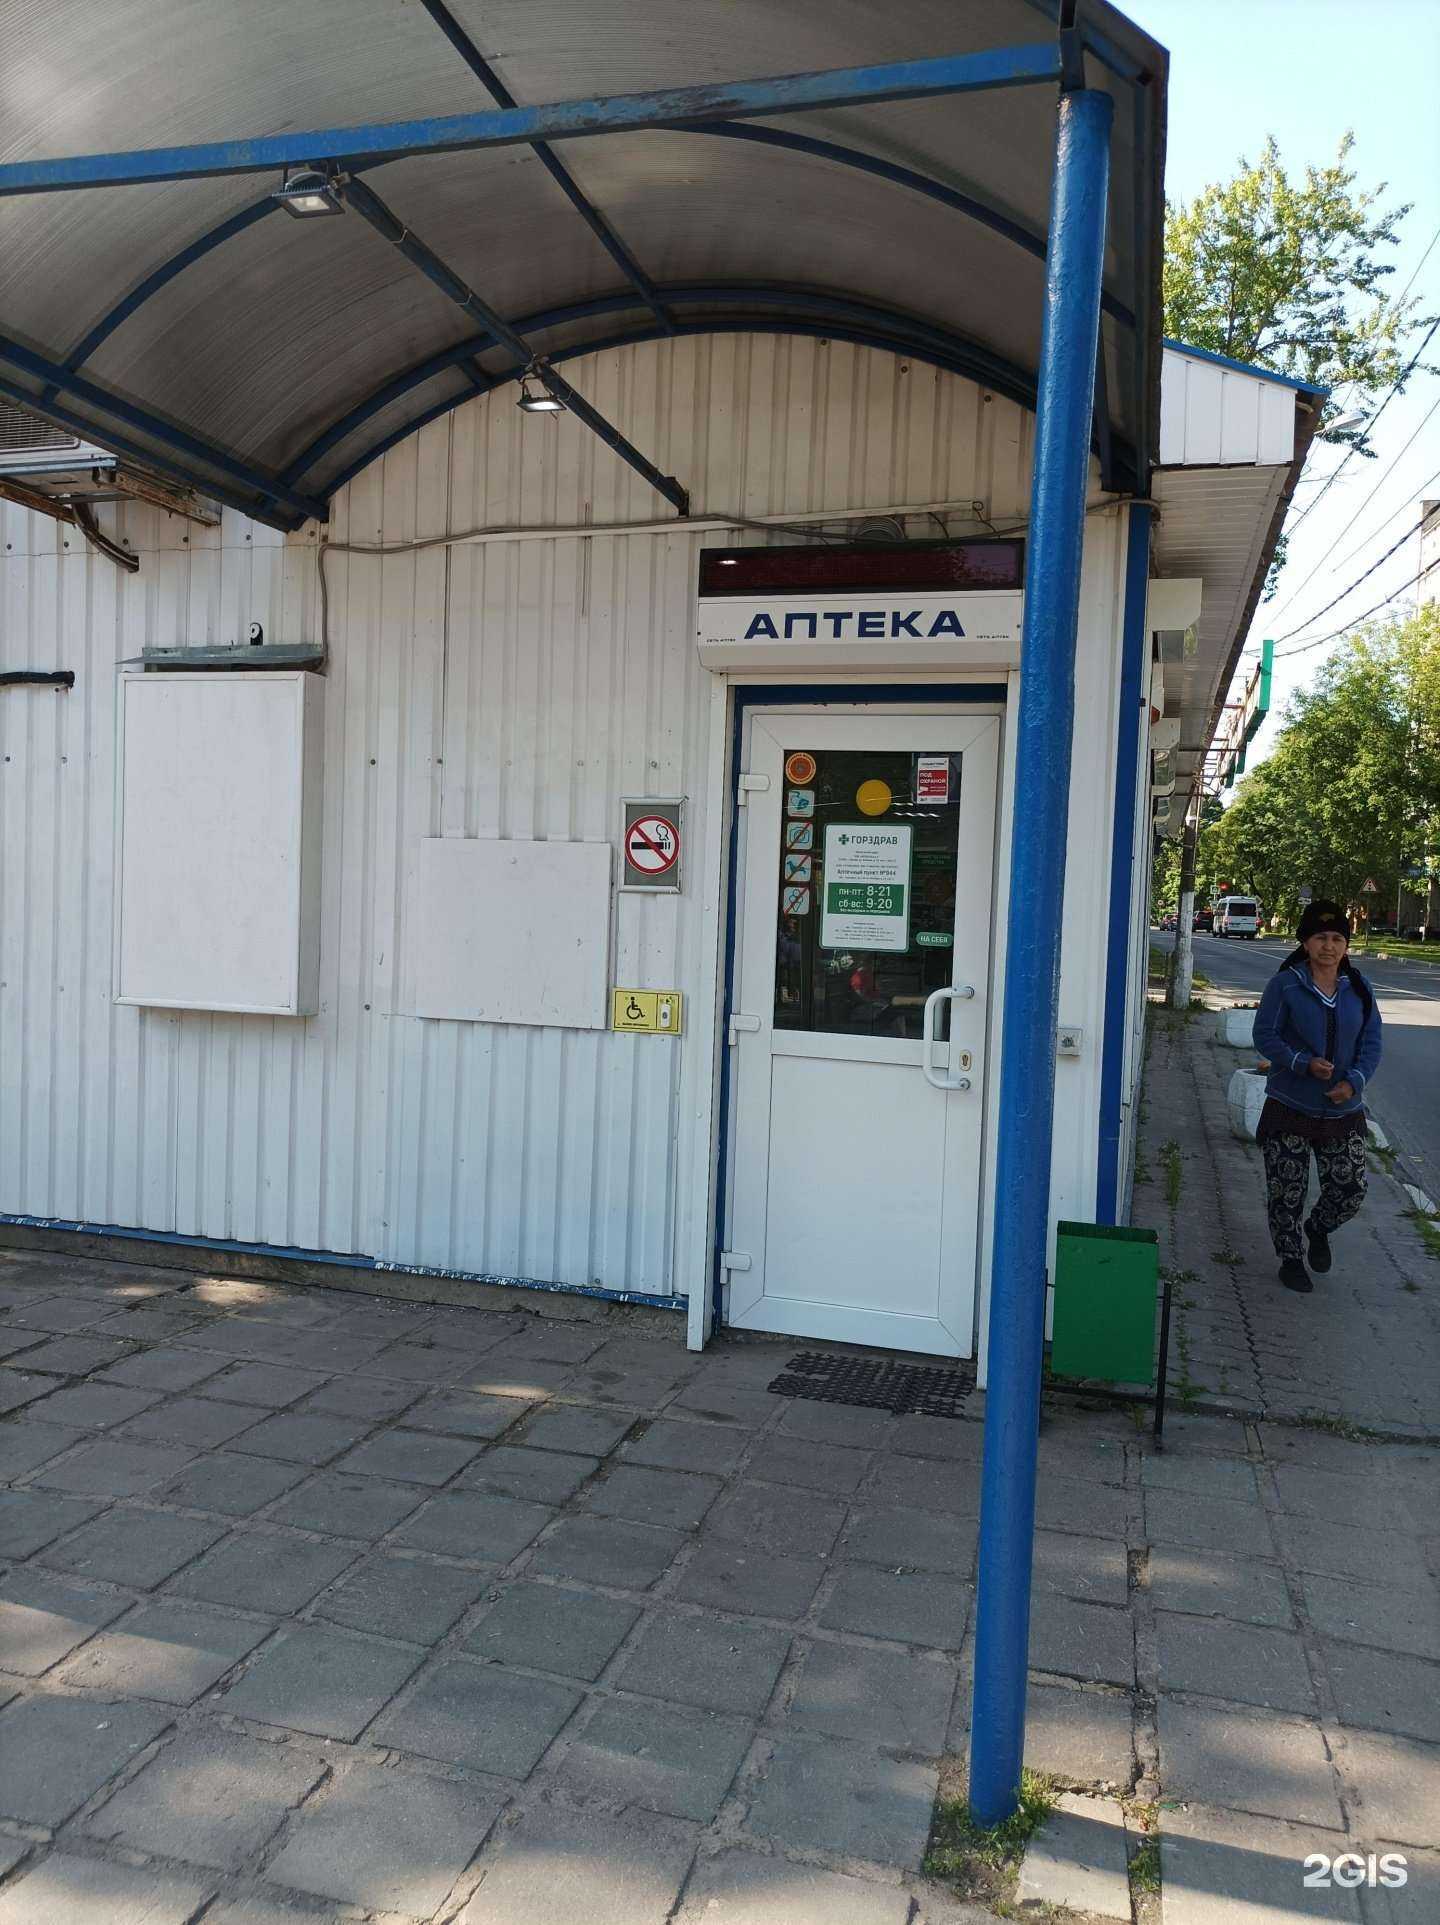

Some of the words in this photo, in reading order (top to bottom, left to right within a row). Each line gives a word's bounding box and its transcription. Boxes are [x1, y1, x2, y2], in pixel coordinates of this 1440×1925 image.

[744, 610, 966, 640] АПТЕКА
[851, 835, 898, 846] ГОРЗДРАВ
[866, 885, 891, 897] 8-21
[866, 898, 893, 909] 9-20
[920, 935, 930, 943] НА
[931, 935, 948, 944] СЕБЯ
